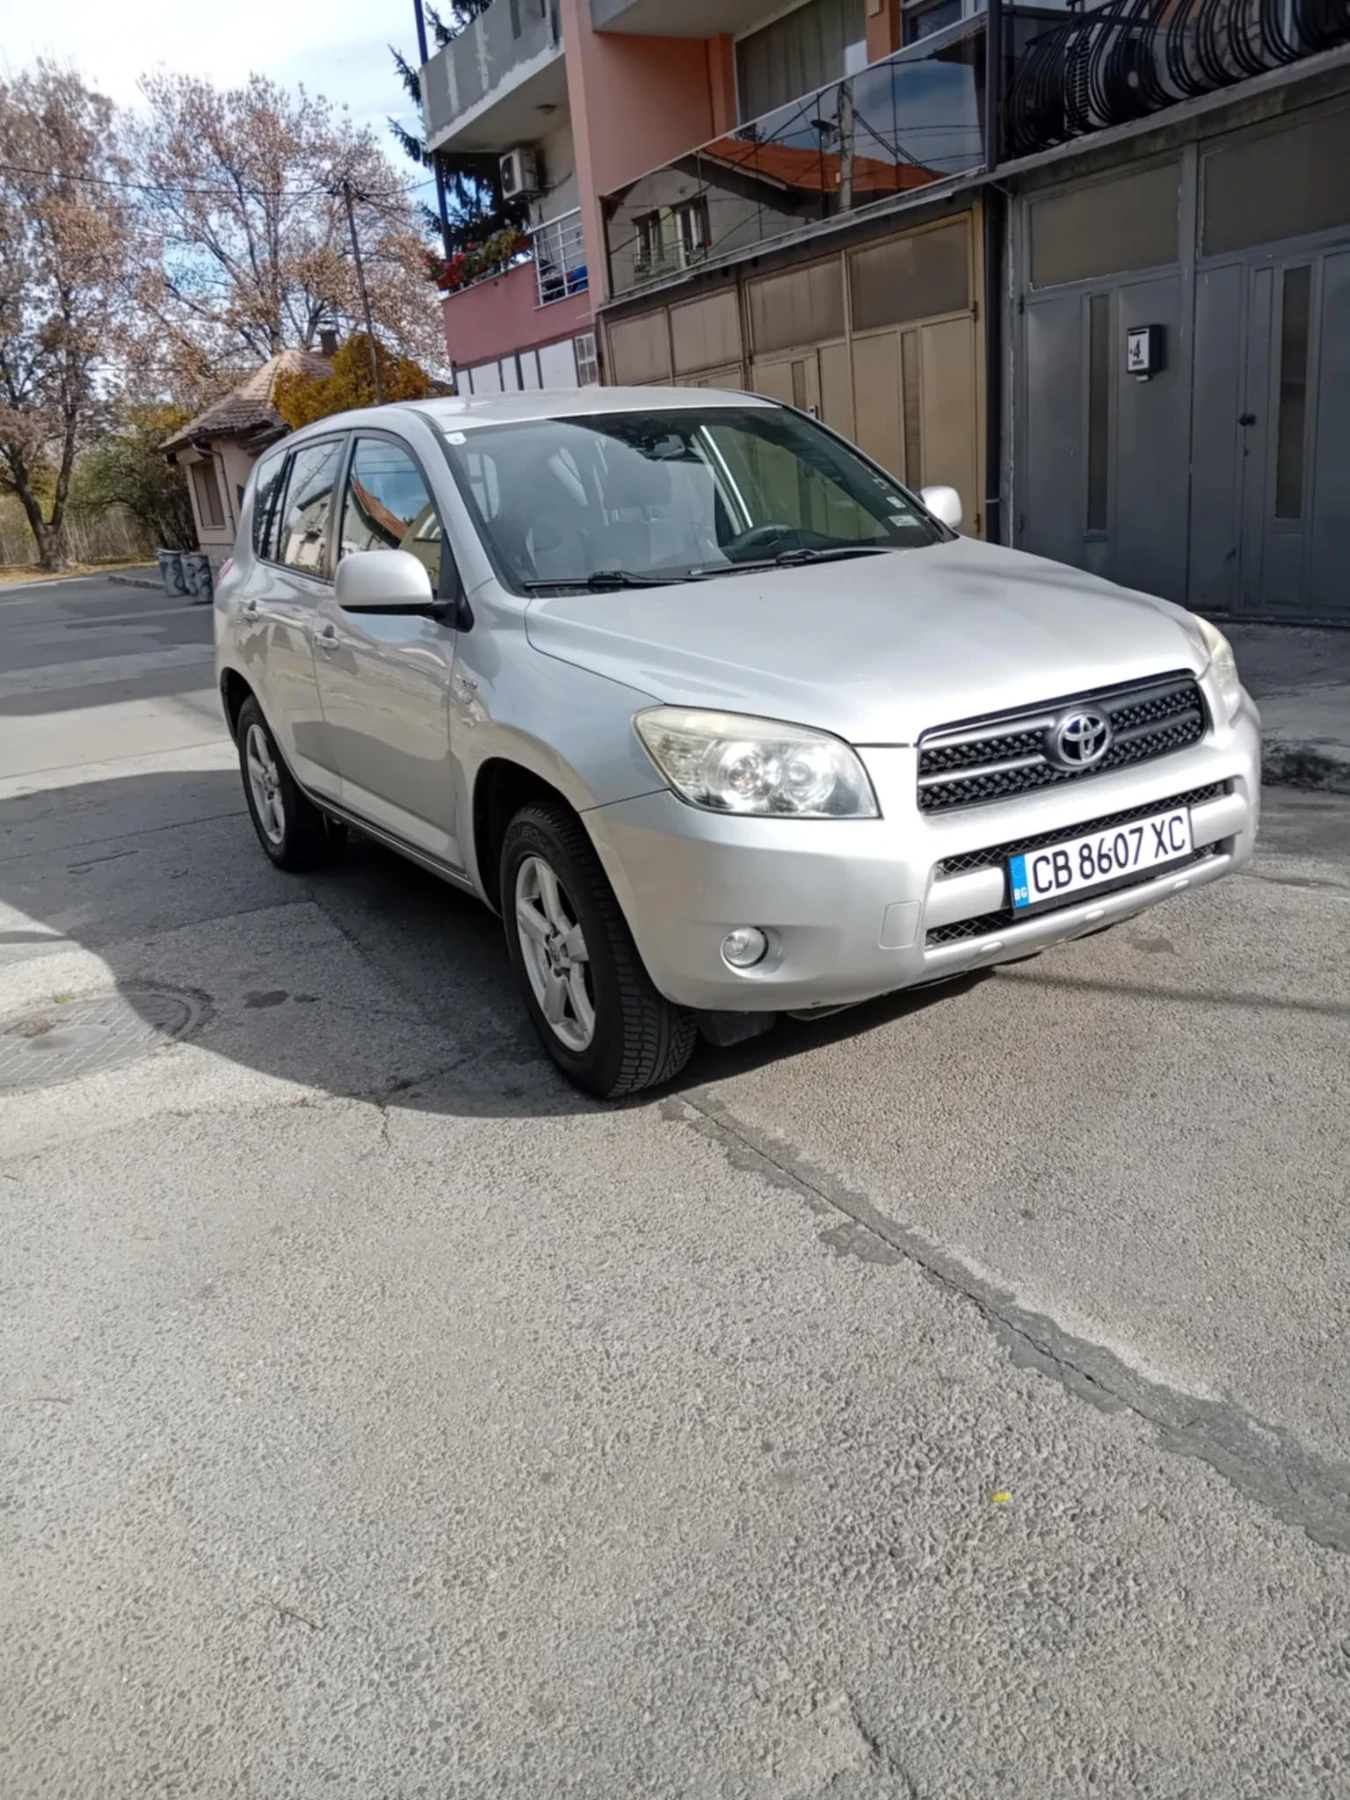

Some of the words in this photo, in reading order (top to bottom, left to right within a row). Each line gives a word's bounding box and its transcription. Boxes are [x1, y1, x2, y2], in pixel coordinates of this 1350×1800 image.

[1032, 850, 1072, 893] CB
[1078, 826, 1144, 879] 8607
[1151, 815, 1186, 858] XC
[1014, 887, 1027, 900] BG
